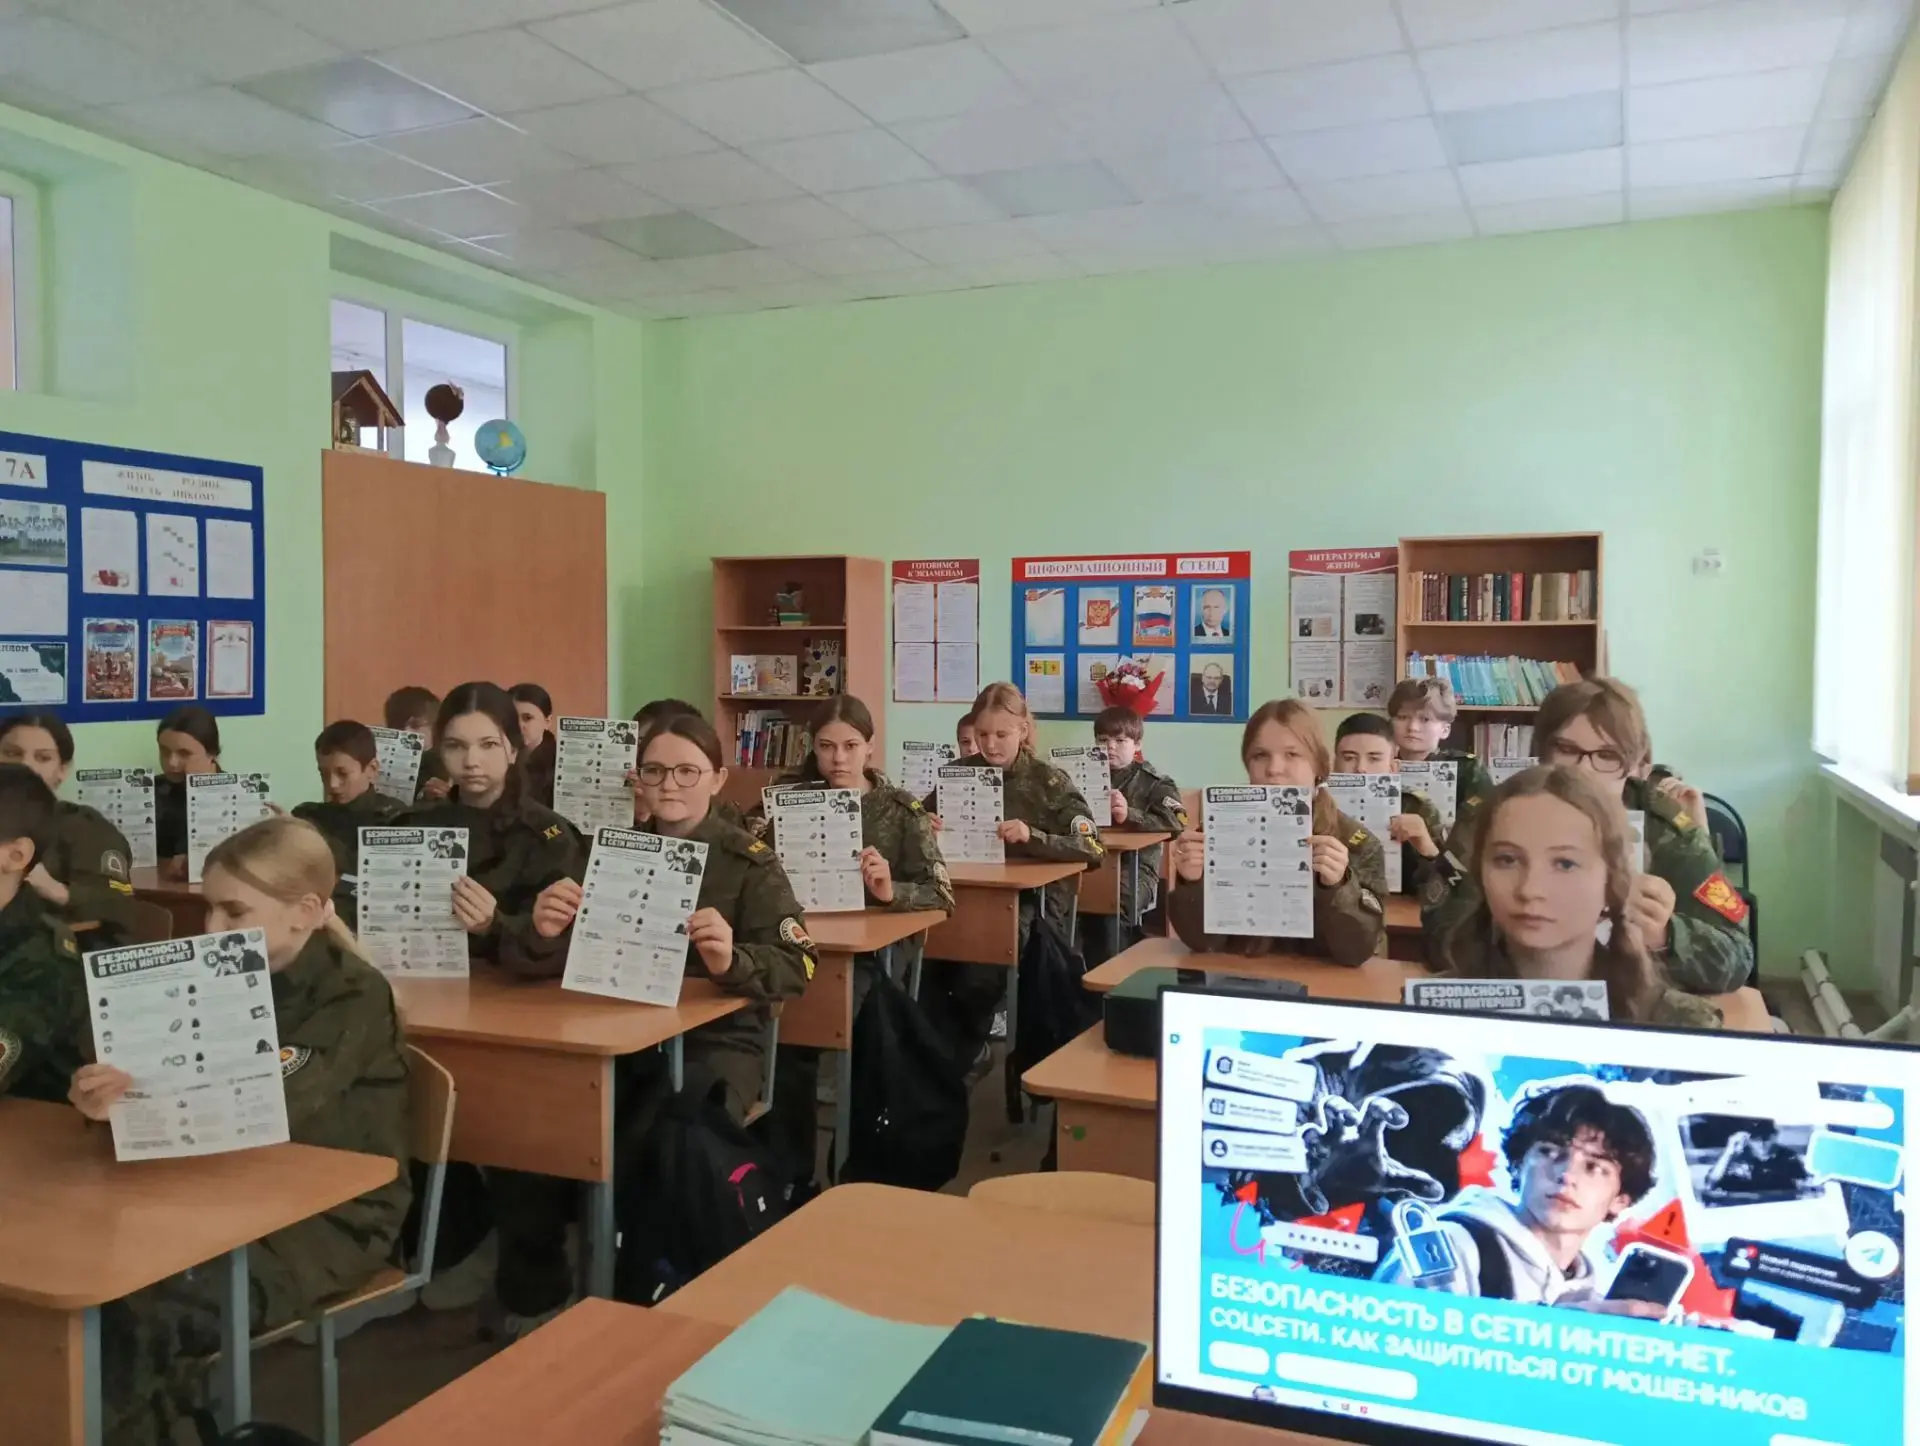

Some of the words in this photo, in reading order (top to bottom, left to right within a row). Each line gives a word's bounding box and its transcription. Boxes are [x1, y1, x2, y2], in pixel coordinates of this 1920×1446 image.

[1306, 551, 1381, 562] ЛИТЕРАТУРНАЯ
[911, 561, 960, 570] ГОТОВИМСЯ
[1027, 560, 1164, 575] ИНФОРМАЦИОННЫЙ
[1179, 558, 1227, 572] СТЕНД
[1326, 561, 1361, 570] ЖИЗНЬ
[915, 569, 963, 577] ЭКЗАМЕНАМ
[780, 791, 825, 799] БЕЗОПАСНОСТЬ
[1210, 787, 1264, 795] БЕЗОПАСНОСТЬ
[367, 829, 422, 838] БЕЗОПАСНОСТЬ
[603, 829, 660, 844] БЕЗОПАСНОСТЬ
[608, 839, 624, 847] СЕТИ
[624, 841, 660, 852] ИНТЕРНЕТ
[97, 941, 189, 964] БЕЗОПАСНОСТЬ
[98, 966, 107, 976] В
[110, 961, 137, 974] СЕТИ
[139, 951, 192, 970] ИНТЕРНЕТ
[1420, 985, 1519, 998] БЕЗОПАСНОСТЬ
[1431, 998, 1460, 1009] СЕТИ
[1463, 997, 1523, 1009] ИНТЕРНЕТ
[1209, 1272, 1438, 1331] БЕЗОПАСНОСТЬ
[1444, 1308, 1464, 1336] В
[1471, 1312, 1552, 1348] СЕТИ
[1559, 1324, 1736, 1377] ИНТЕРНЕТ.
[1209, 1306, 1326, 1344] СОЦСЕТИ.
[1331, 1326, 1381, 1353] КАК
[1384, 1335, 1558, 1381] ЗАЩИТИТЬСЯ
[1561, 1360, 1598, 1386] ОТ
[1603, 1368, 1808, 1421] МОШЕННИКОВ
